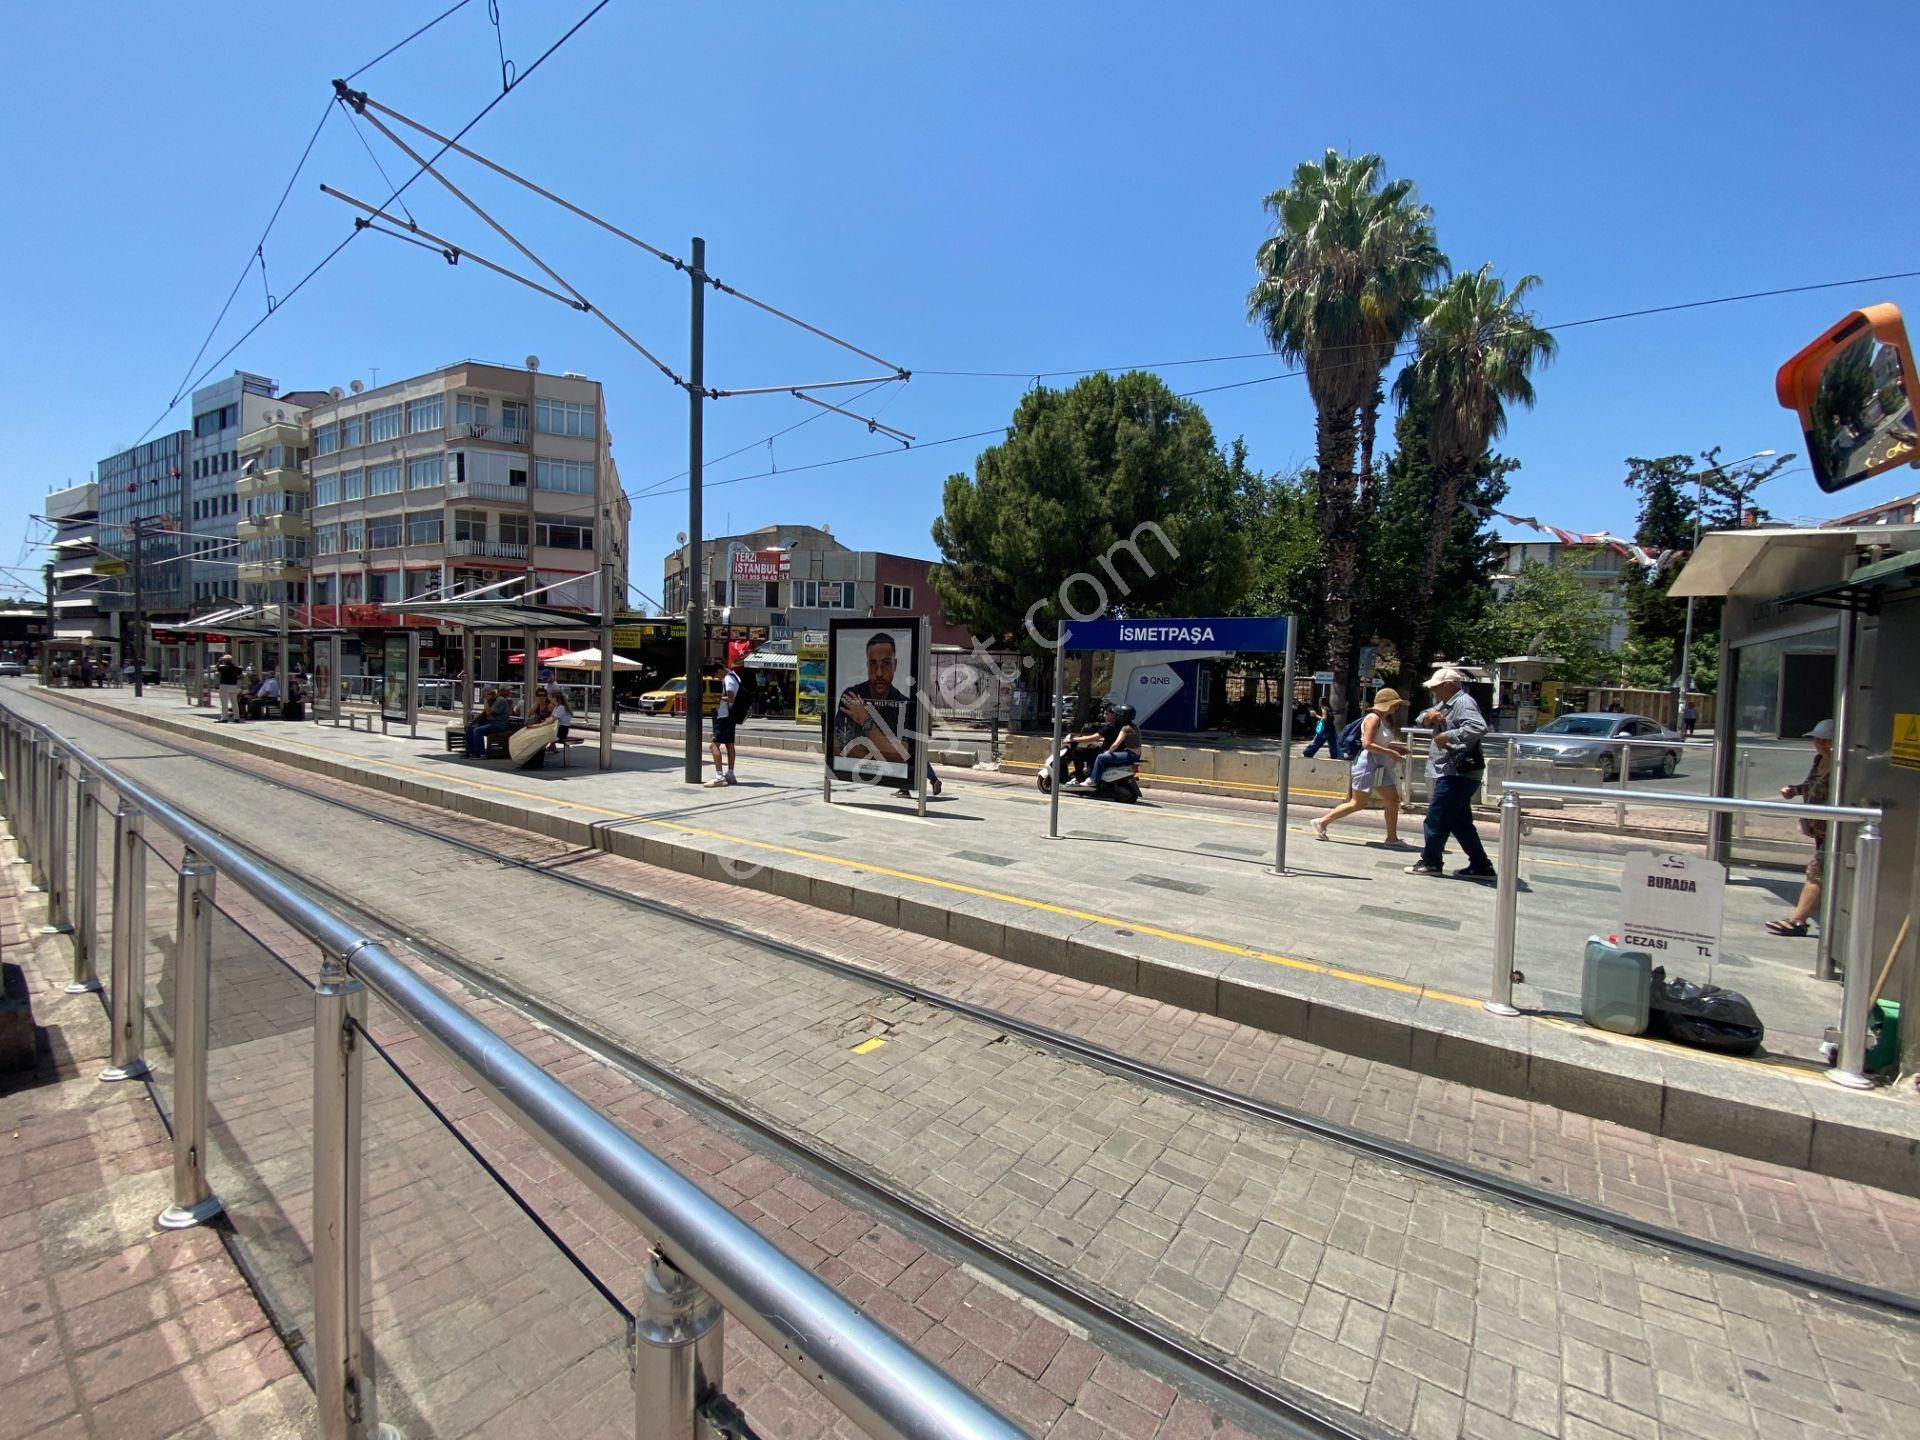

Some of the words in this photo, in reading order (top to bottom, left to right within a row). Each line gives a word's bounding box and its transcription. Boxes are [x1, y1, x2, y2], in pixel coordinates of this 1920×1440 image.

[1119, 625, 1215, 644] İSMETPAŞA
[1150, 676, 1170, 685] QNB
[1647, 875, 1697, 893] BURADA
[1624, 935, 1668, 950] CEZASI
[1696, 946, 1712, 957] TL
